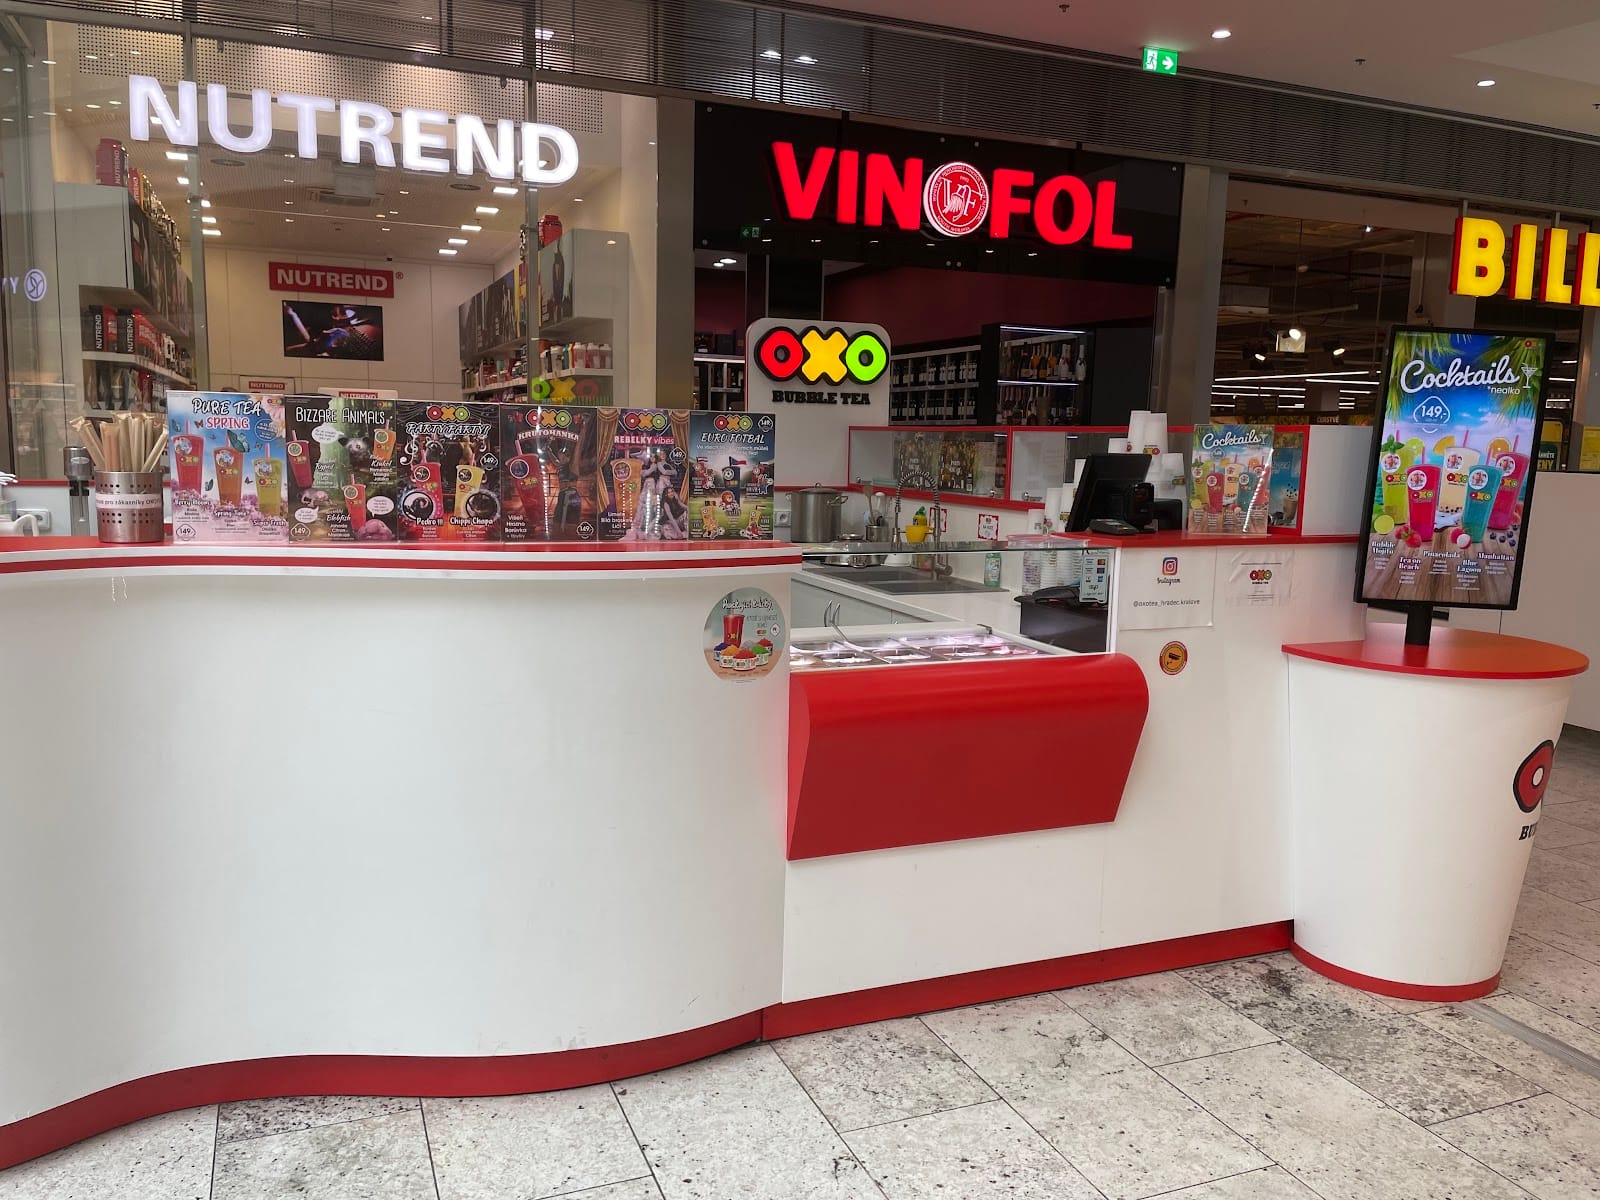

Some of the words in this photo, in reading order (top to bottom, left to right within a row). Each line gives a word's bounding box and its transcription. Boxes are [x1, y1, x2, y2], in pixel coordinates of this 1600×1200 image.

[128, 74, 579, 184] NUTREND
[277, 269, 388, 292] NUTREND
[95, 314, 103, 349] NUTREND
[754, 326, 889, 386] OXO
[1400, 355, 1520, 393] Cocktails
[772, 390, 837, 405] BUBBLE
[841, 392, 871, 405] TEA
[192, 398, 230, 415] PURE
[234, 399, 262, 416] TEA
[296, 406, 337, 423] BIZZARE
[206, 417, 250, 430] SPRING
[407, 422, 444, 434] PARTY
[614, 435, 652, 444] REBELKY
[701, 432, 727, 442] EURO
[729, 433, 765, 444] FOTBAL
[1202, 429, 1261, 449] Cocktails
[1157, 577, 1181, 586] Instagram
